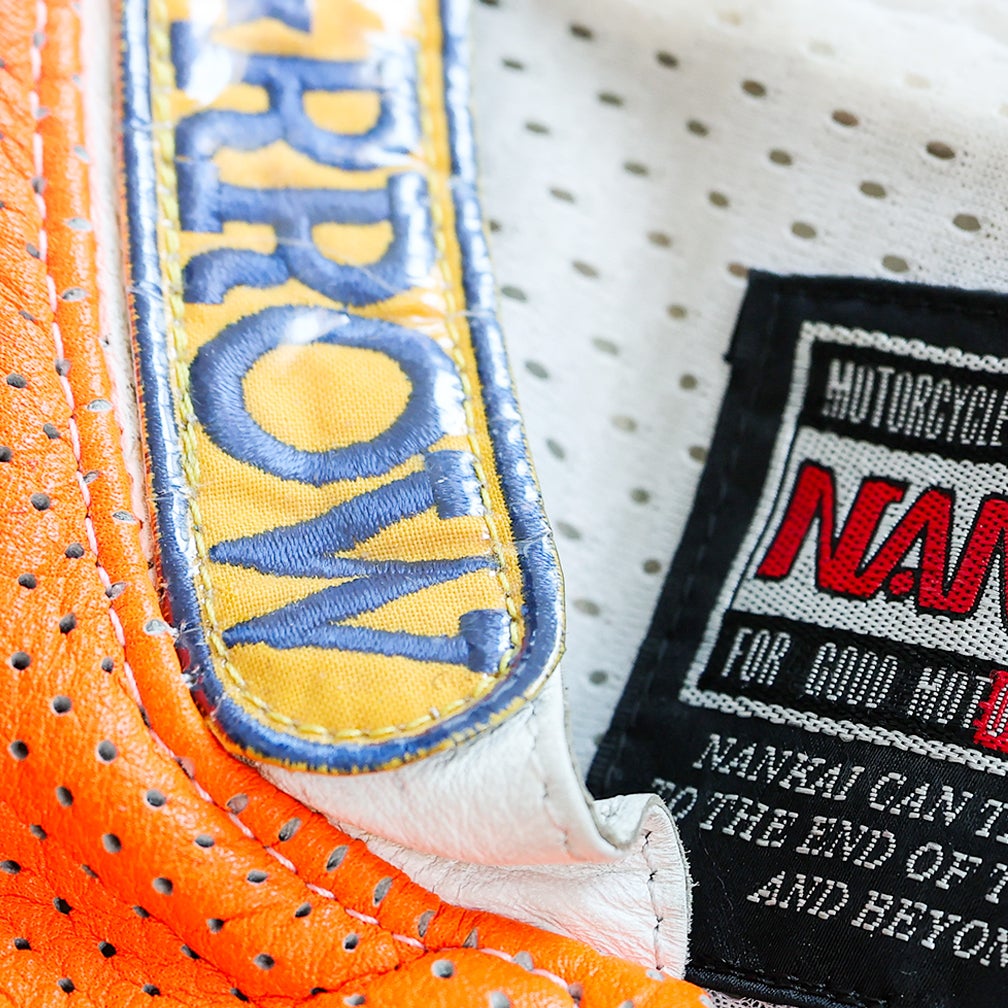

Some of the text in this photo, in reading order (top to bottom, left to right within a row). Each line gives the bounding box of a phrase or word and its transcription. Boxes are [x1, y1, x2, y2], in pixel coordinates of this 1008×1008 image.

[721, 627, 792, 687] FOR
[805, 641, 898, 709] GOOD
[692, 733, 866, 801] NANKAI
[868, 772, 974, 827] CAN
[699, 792, 799, 849] THE
[795, 815, 897, 870] END
[905, 841, 983, 890] OF
[746, 869, 850, 920] AND
